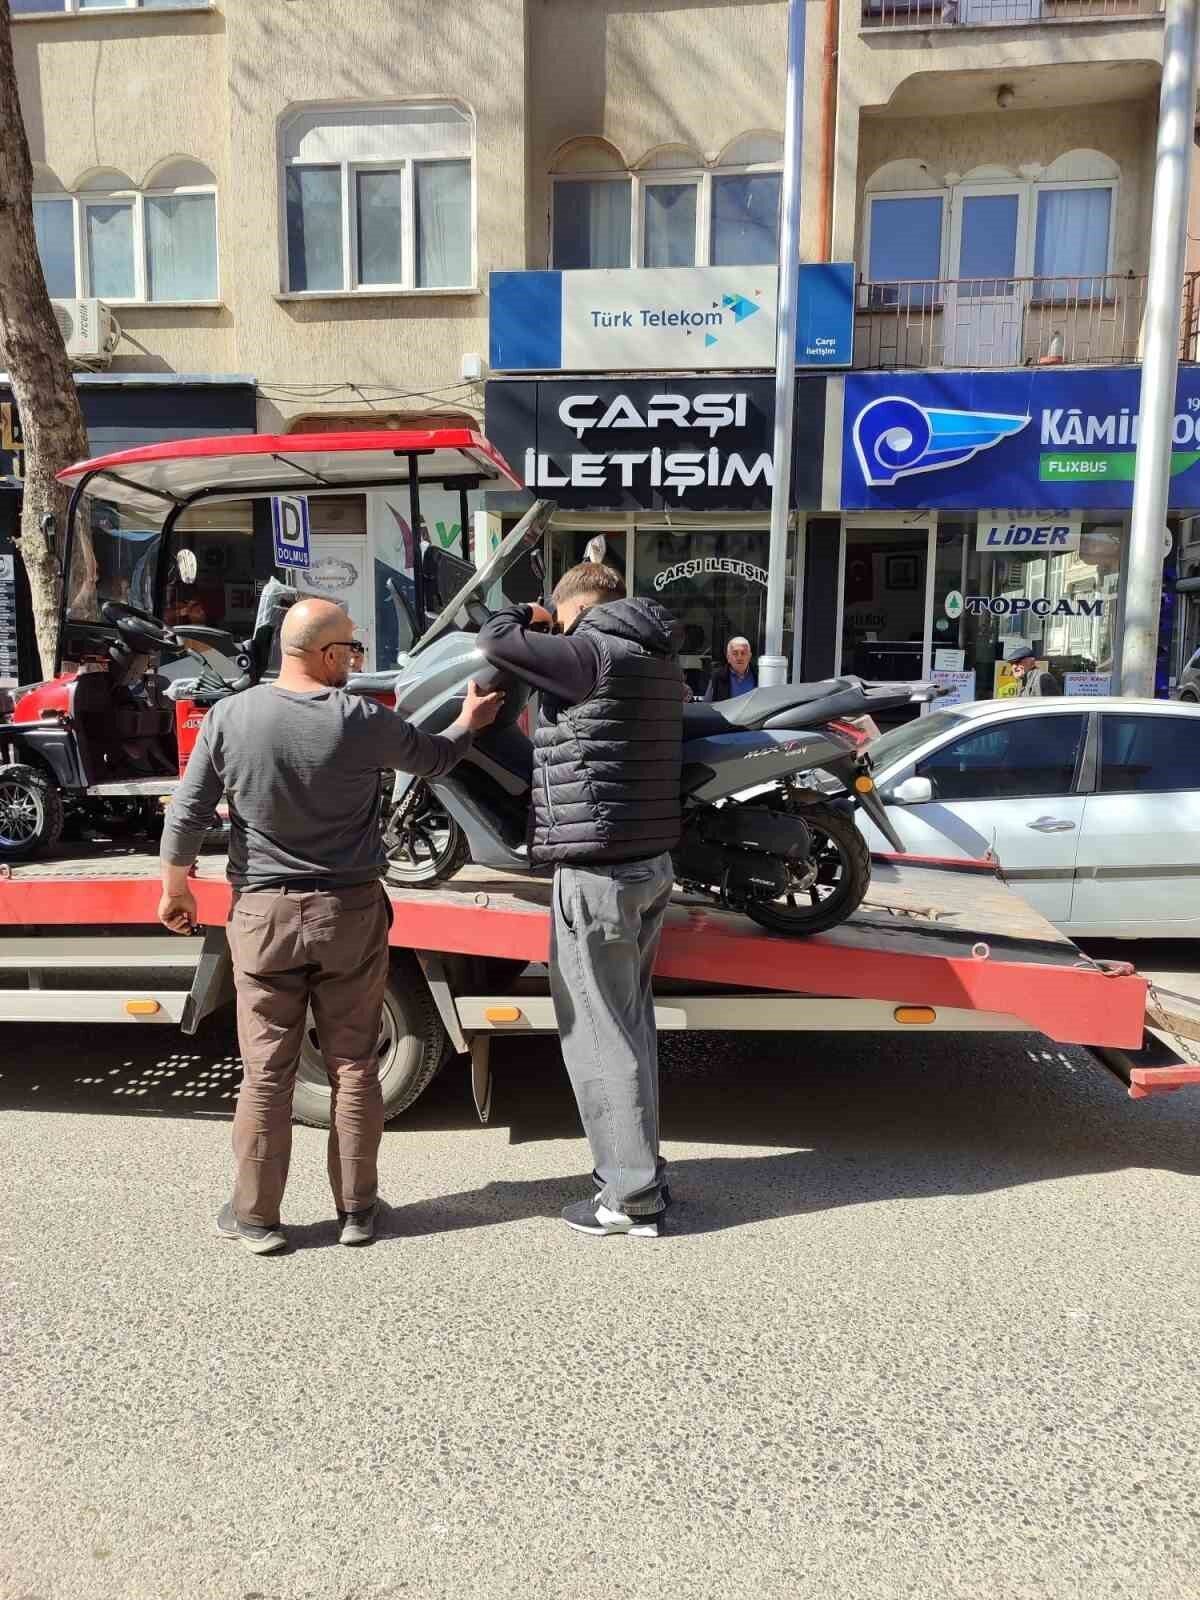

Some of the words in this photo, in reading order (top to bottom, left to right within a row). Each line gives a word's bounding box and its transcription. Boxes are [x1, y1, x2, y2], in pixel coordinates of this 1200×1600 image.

[591, 310, 633, 328] Türk
[640, 309, 722, 328] Telekom
[558, 393, 747, 439] ÇARŞI
[525, 447, 775, 497] İLETİŞİM
[281, 500, 301, 541] D
[654, 559, 702, 591] ÇARŞI
[965, 597, 1105, 620] TOPÇAM
